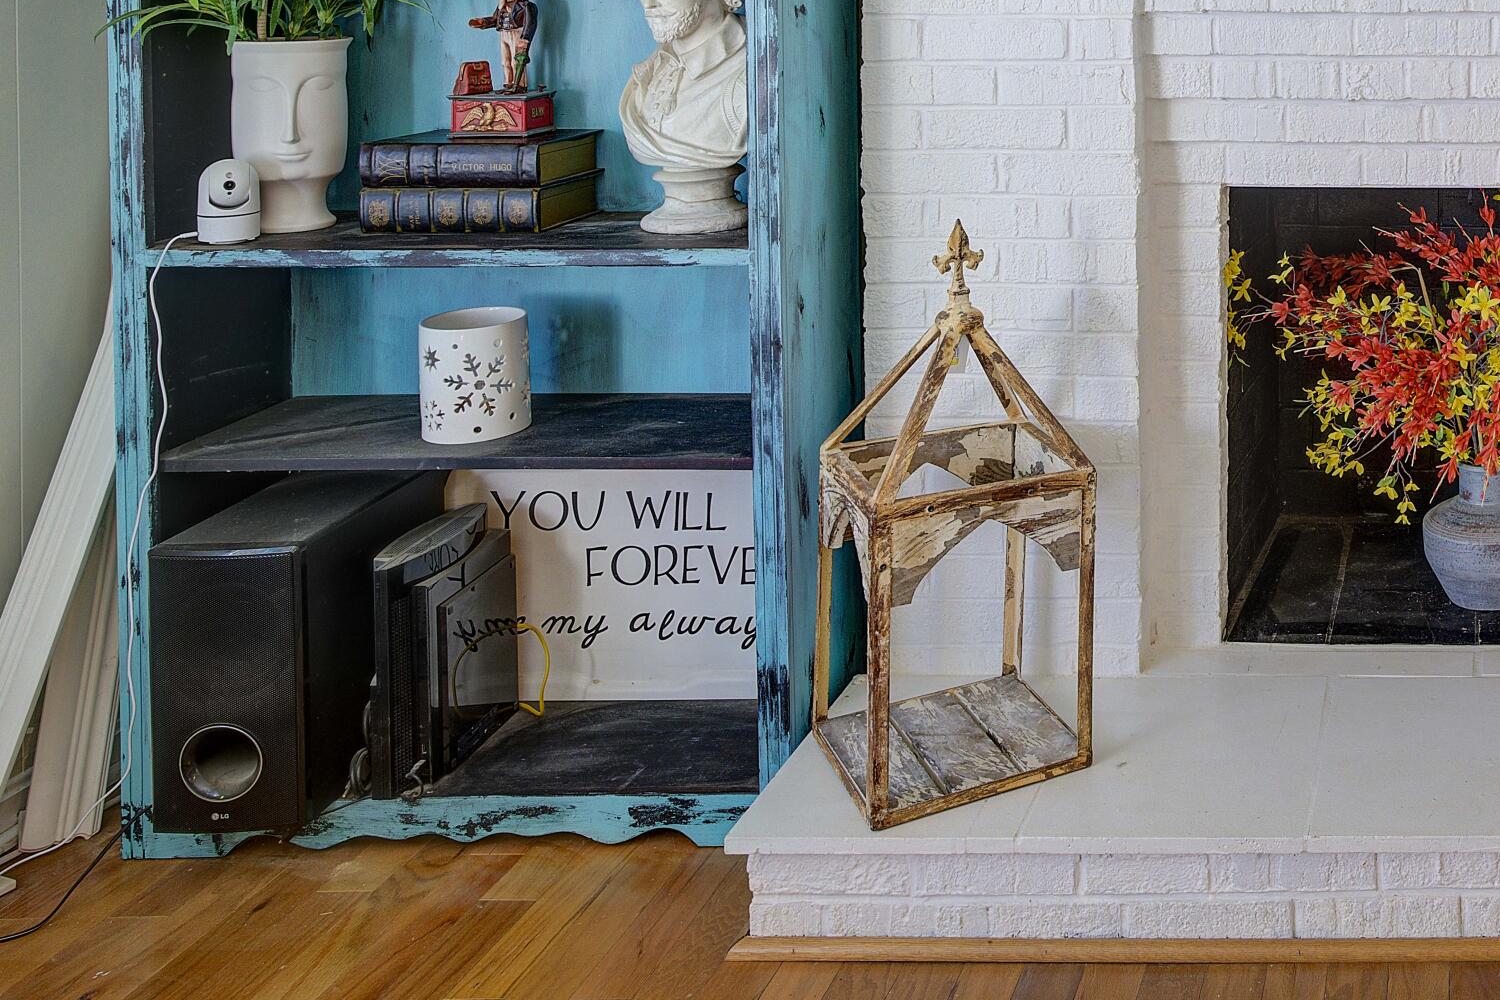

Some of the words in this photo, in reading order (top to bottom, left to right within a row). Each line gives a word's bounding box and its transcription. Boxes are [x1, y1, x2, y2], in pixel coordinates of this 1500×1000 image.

[451, 163, 485, 172] VICTOR
[489, 163, 512, 172] HUGO
[490, 490, 606, 531] YOU
[625, 490, 727, 531] WILL
[541, 614, 608, 649] my
